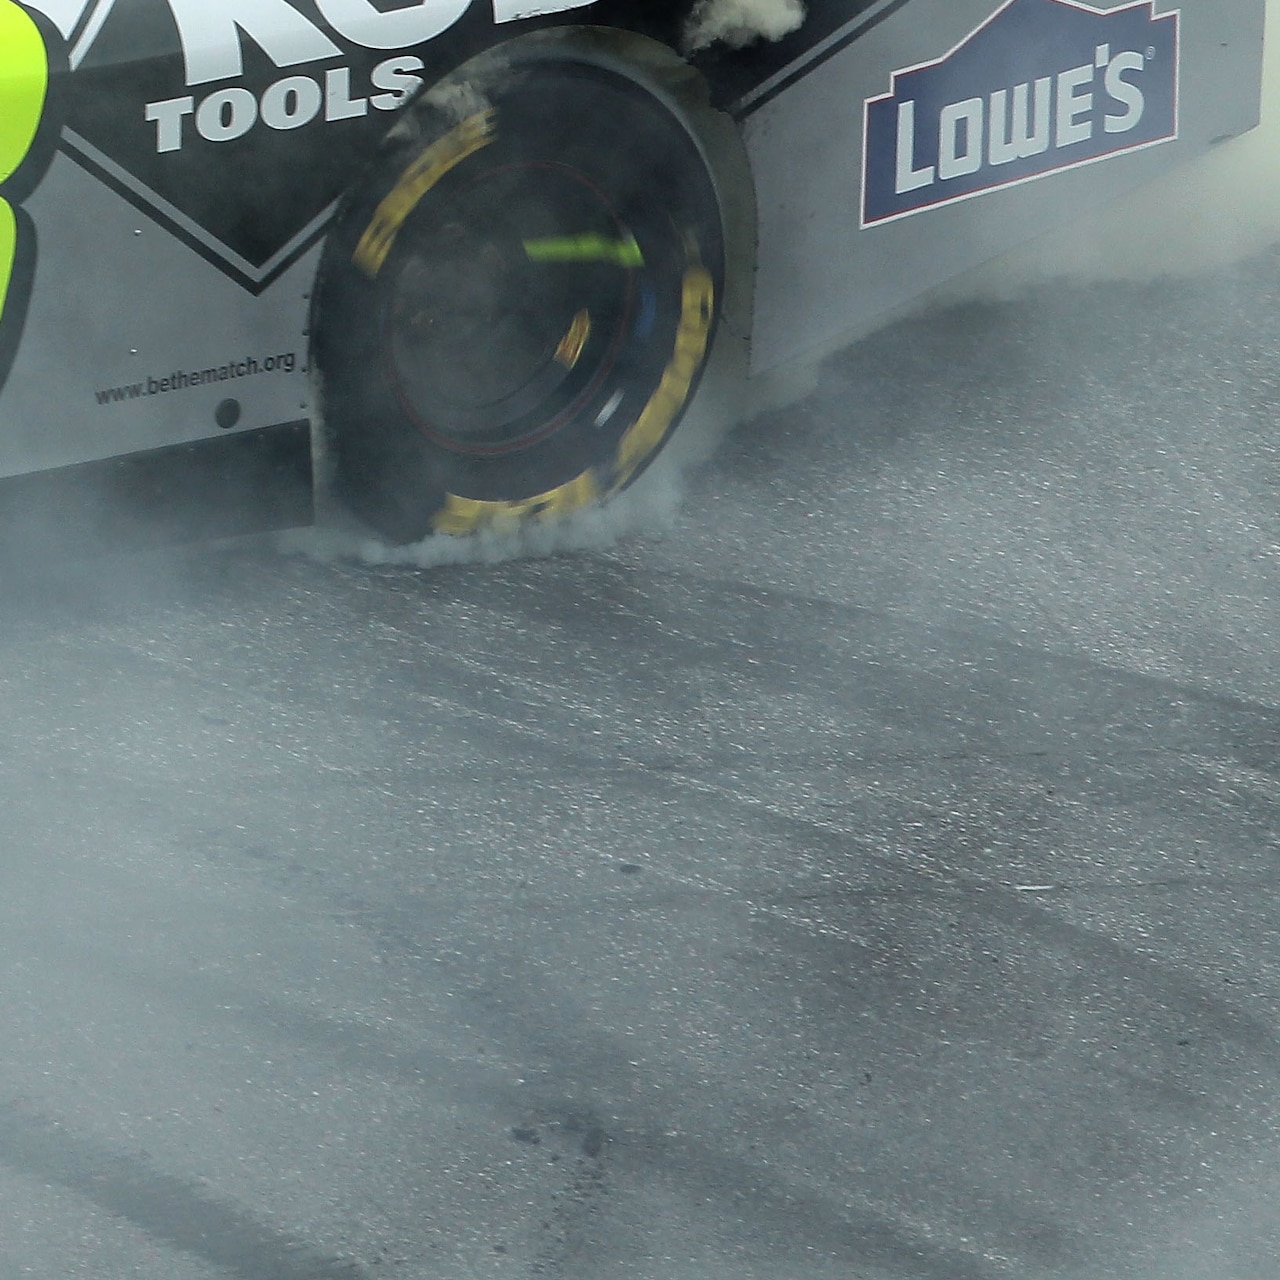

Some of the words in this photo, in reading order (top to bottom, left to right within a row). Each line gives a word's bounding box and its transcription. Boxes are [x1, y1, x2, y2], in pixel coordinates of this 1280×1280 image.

[144, 55, 426, 152] TOOLS
[895, 43, 1145, 195] LOWE'S
[95, 352, 296, 405] www.bethematch.org
